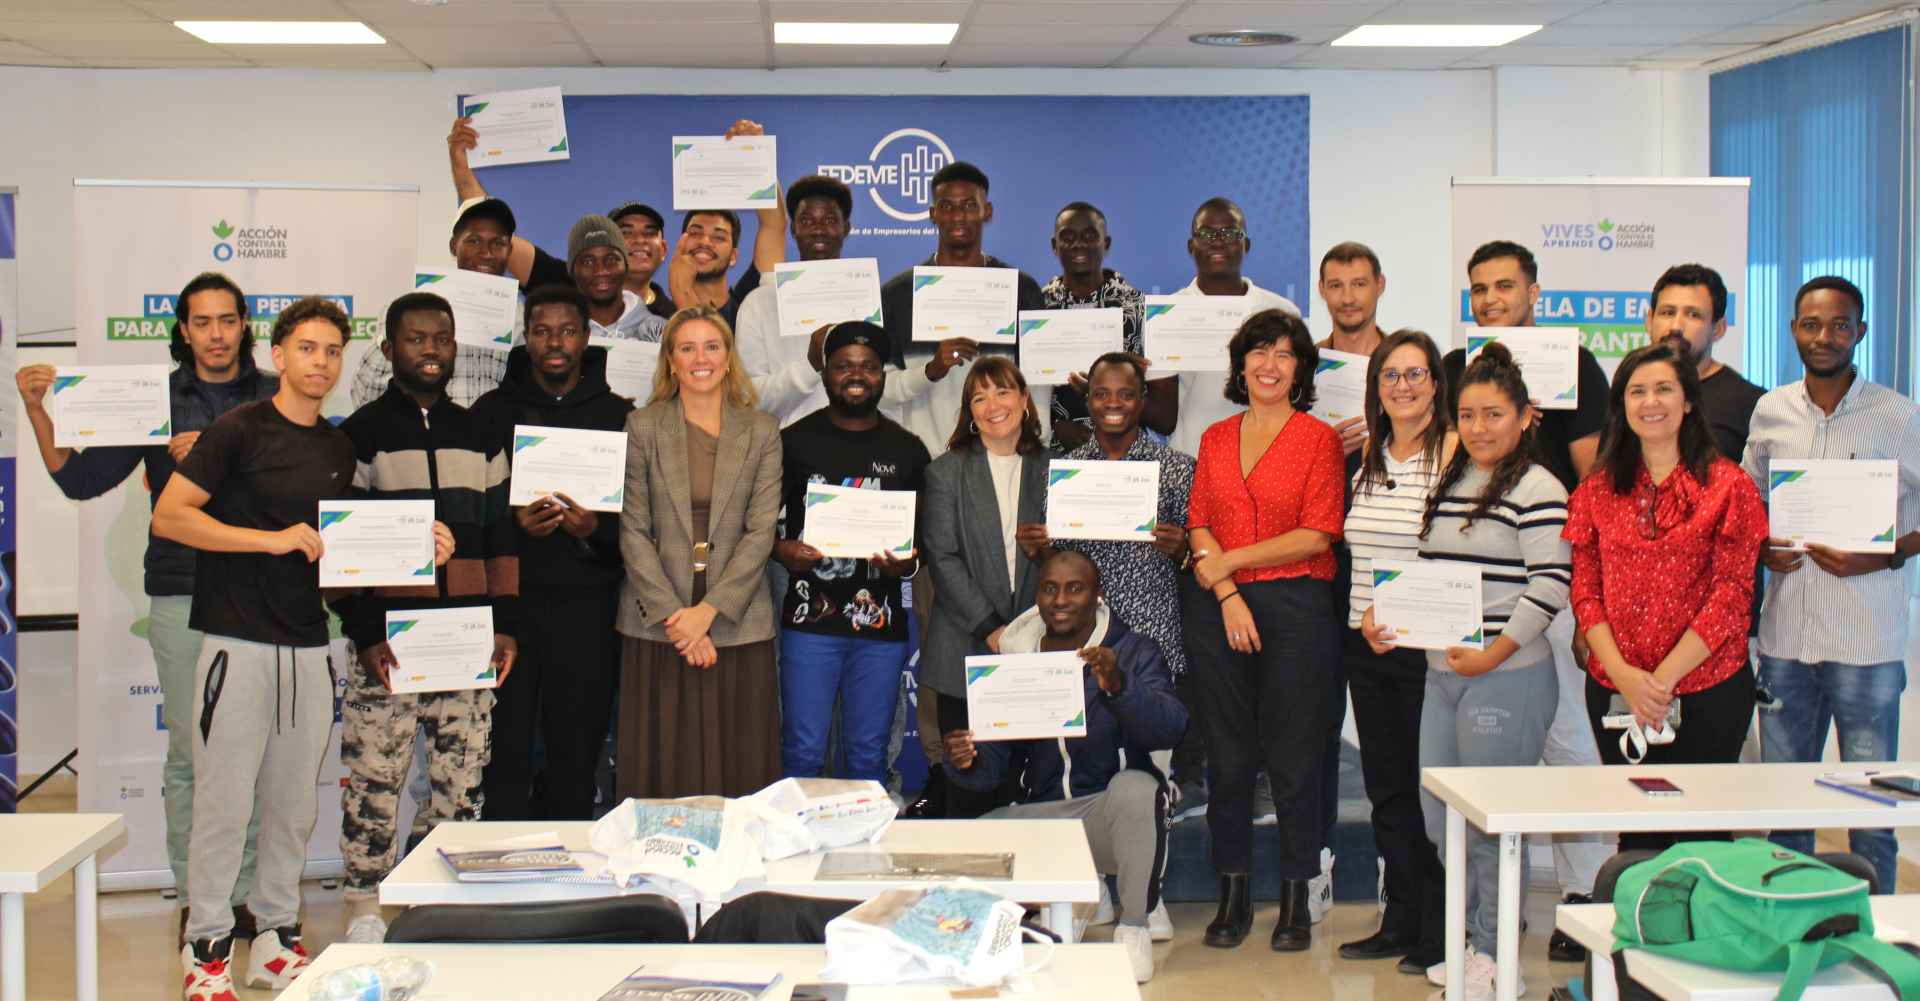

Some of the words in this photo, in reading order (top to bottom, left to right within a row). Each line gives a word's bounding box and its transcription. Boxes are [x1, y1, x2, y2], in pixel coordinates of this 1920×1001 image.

[817, 165, 898, 184] FEDEME
[238, 225, 288, 239] ACCIÓN
[873, 227, 920, 237] Empresarios
[1542, 224, 1594, 238] VIVES
[1617, 221, 1655, 233] ACCIÓN
[1543, 240, 1594, 248] APRENDE
[1616, 240, 1655, 249] HAMBRE
[237, 249, 288, 259] HAMBRE
[149, 297, 175, 314] LA
[1584, 297, 1616, 319] DE
[113, 320, 169, 337] PARA
